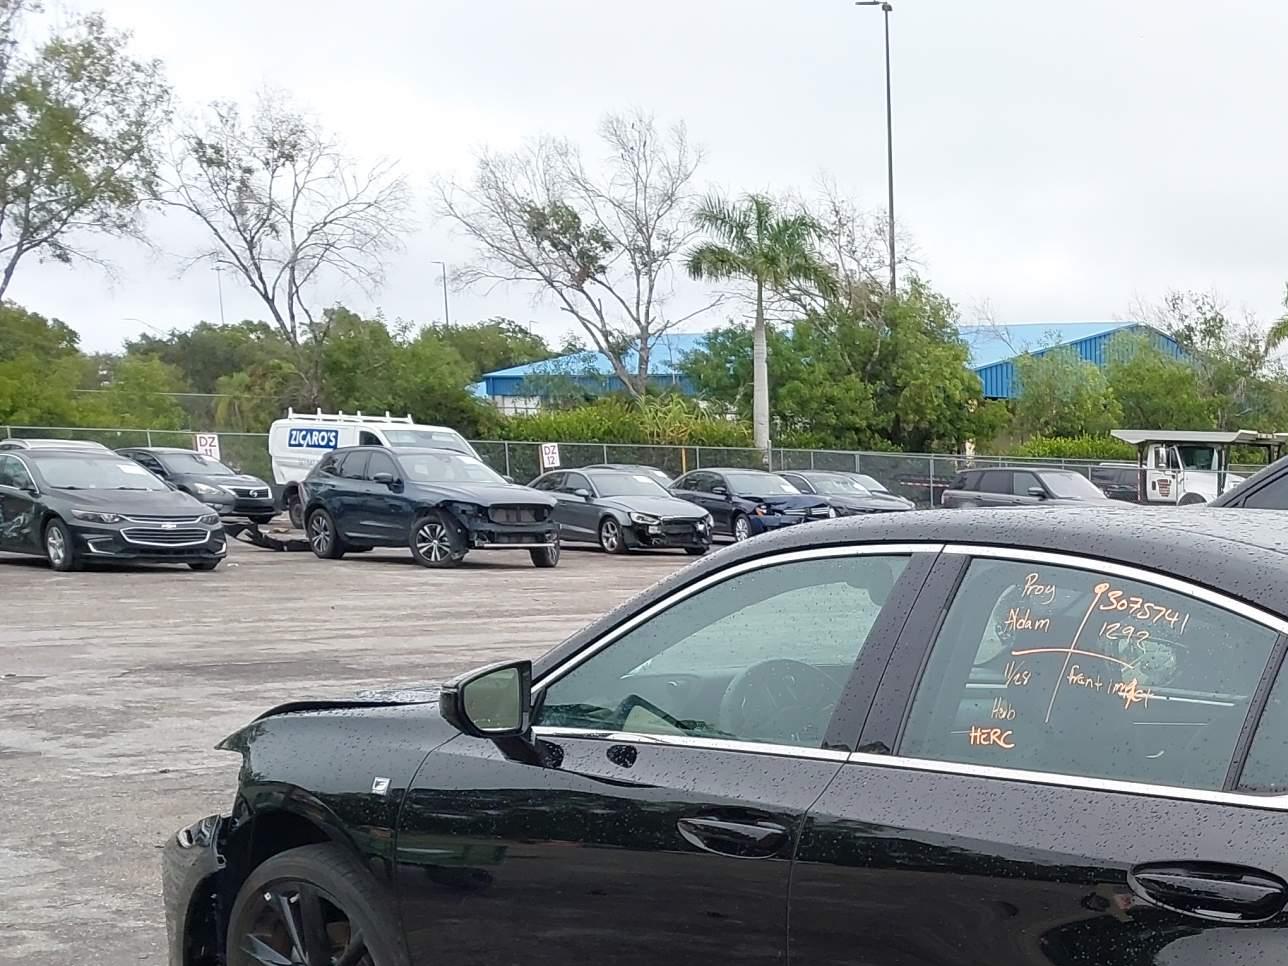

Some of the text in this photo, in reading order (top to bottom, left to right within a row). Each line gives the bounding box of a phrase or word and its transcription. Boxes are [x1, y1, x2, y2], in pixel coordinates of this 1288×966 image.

[199, 436, 217, 448] DZ
[290, 430, 337, 448] ZICARO'S
[543, 445, 557, 456] DZ
[547, 455, 556, 465] 12
[1005, 607, 1050, 633] Adam
